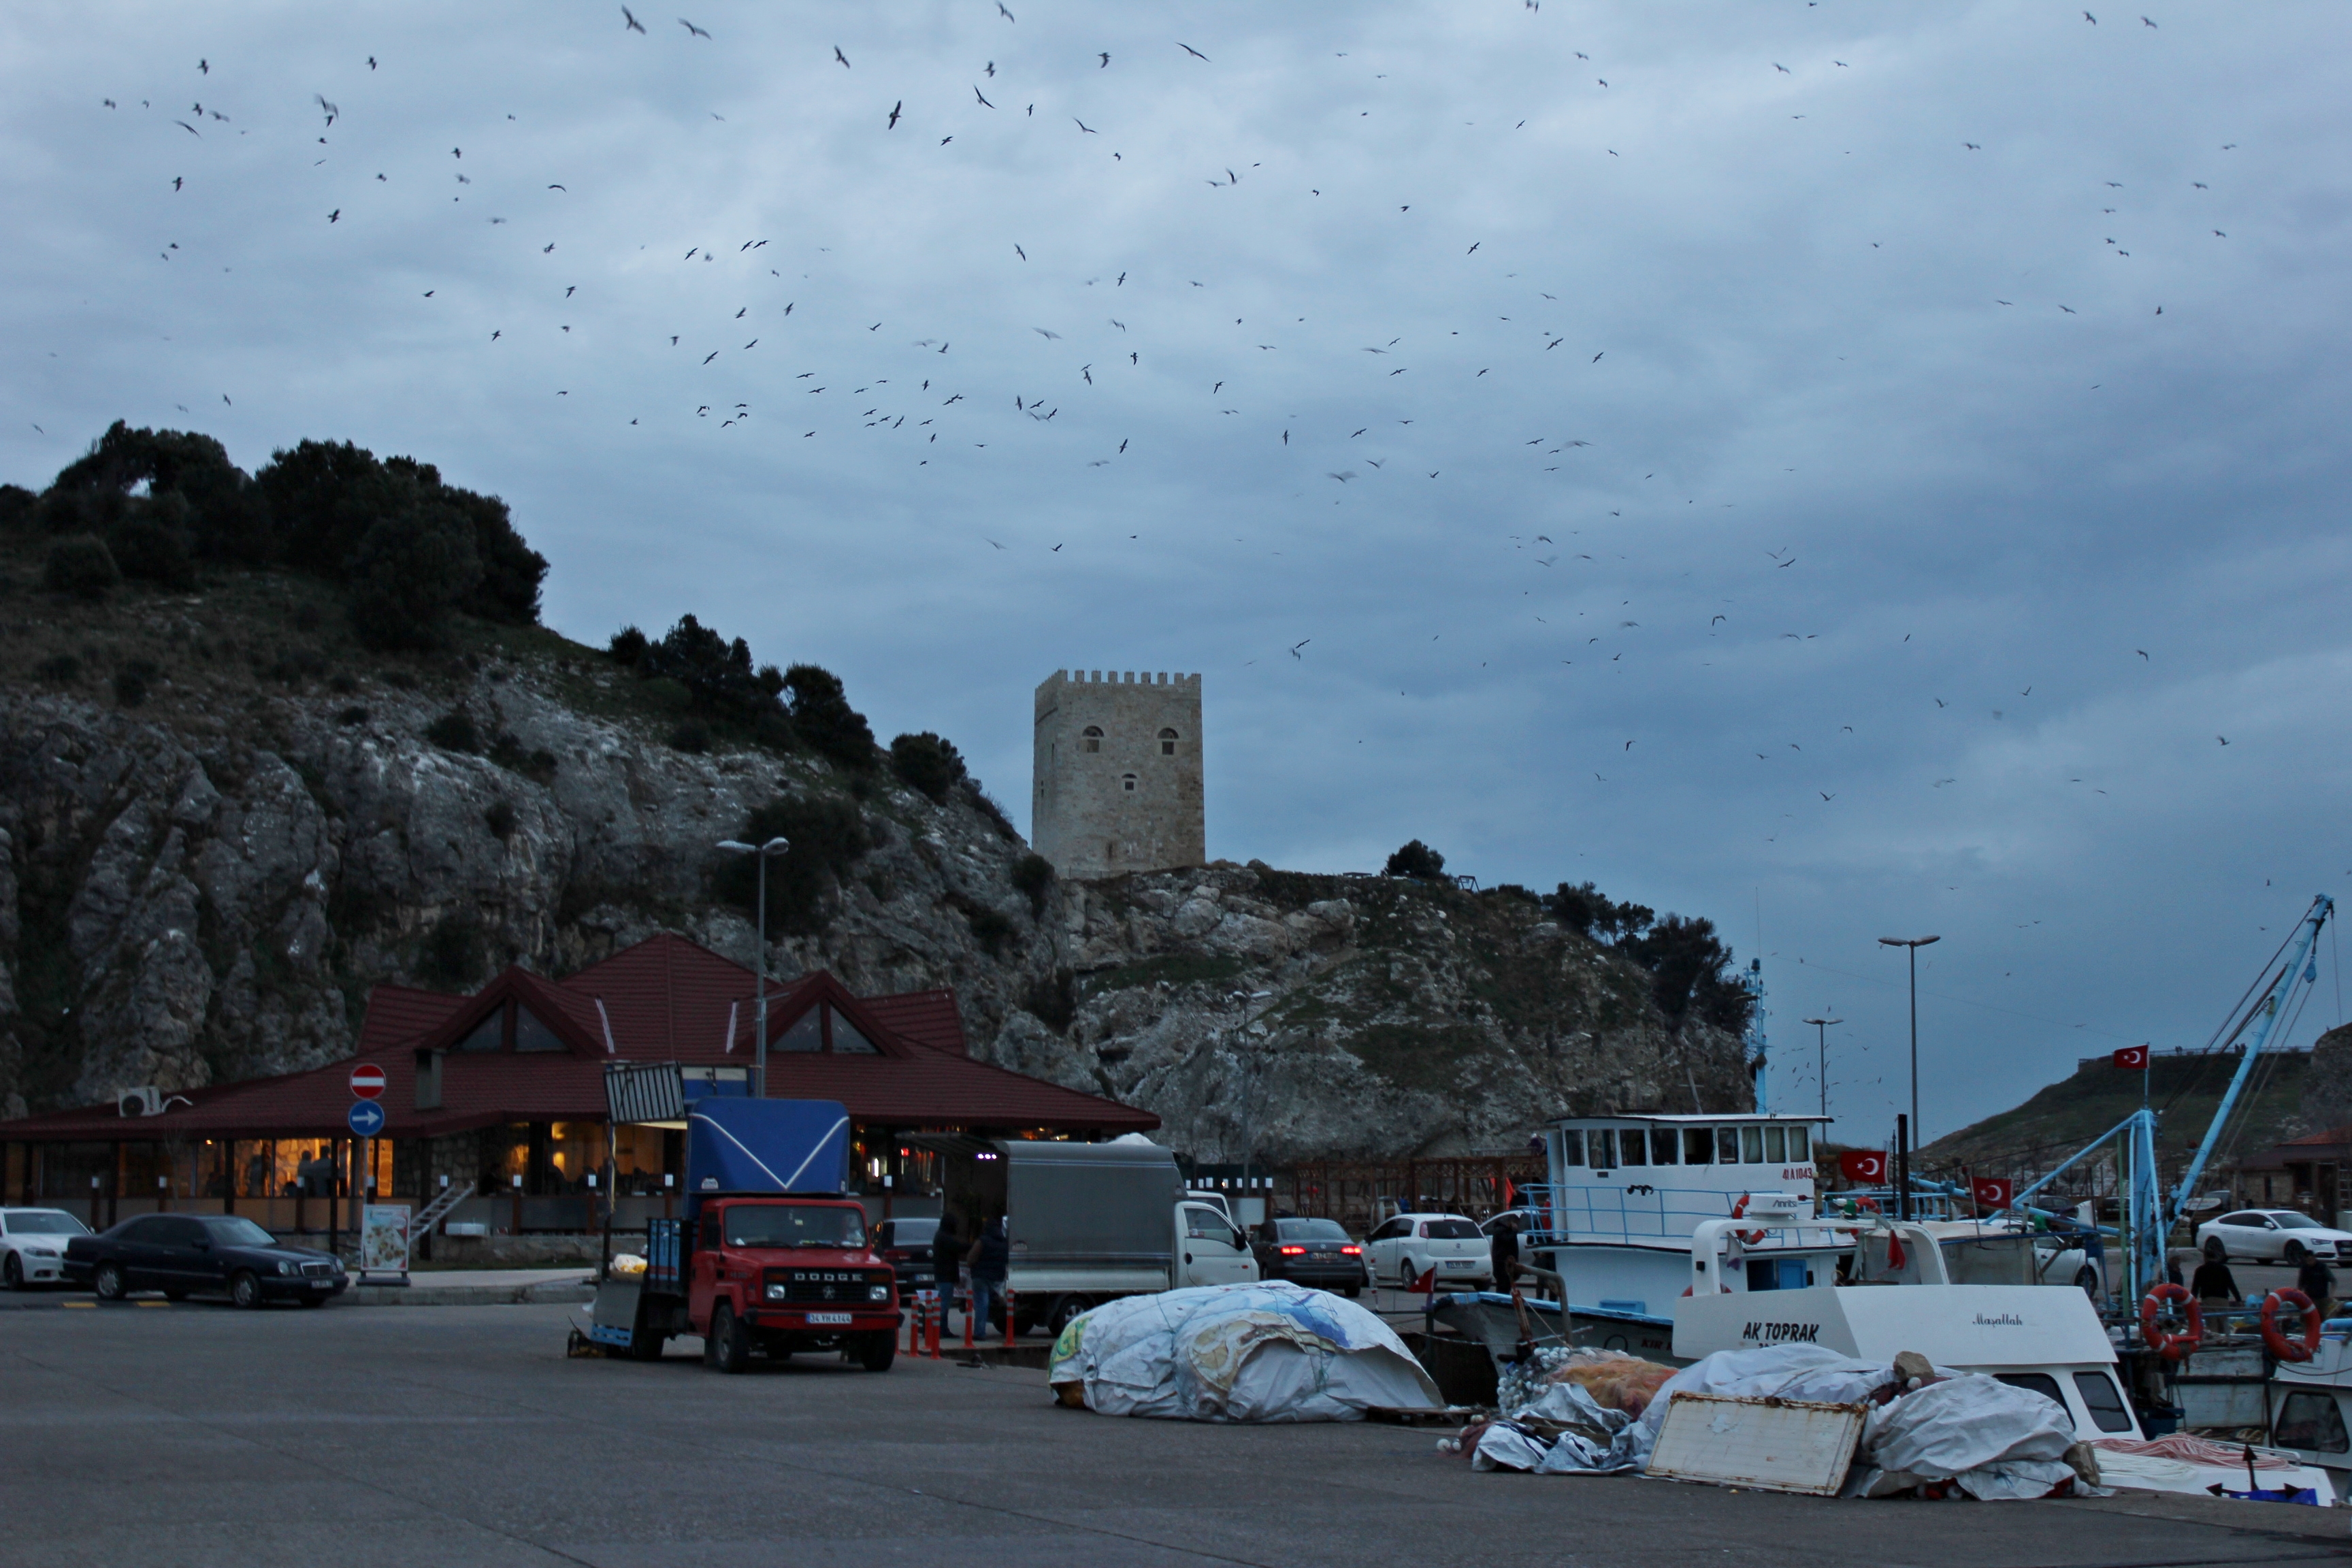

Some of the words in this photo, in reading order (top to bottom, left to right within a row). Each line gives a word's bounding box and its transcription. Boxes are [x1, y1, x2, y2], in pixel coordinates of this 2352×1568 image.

[794, 1272, 863, 1282] DODGE
[1972, 1313, 2023, 1328] Maşallah
[1743, 1322, 1762, 1340] AK
[1765, 1322, 1820, 1343] TOPRAK
